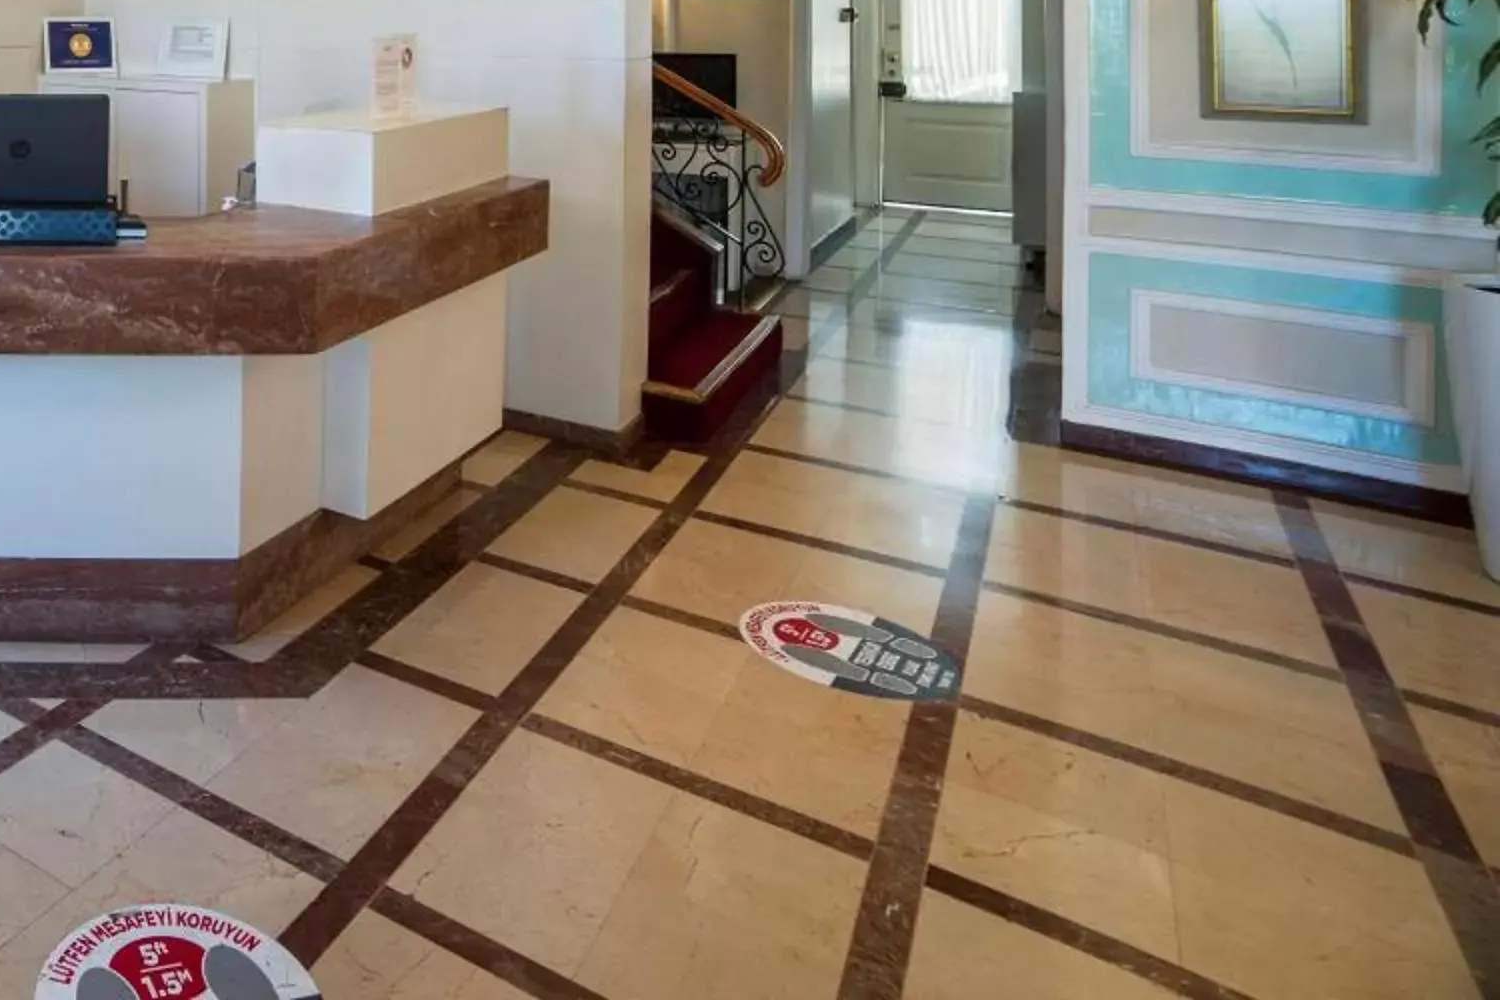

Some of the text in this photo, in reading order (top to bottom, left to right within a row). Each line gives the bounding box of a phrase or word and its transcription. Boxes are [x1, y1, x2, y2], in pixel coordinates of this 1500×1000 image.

[49, 906, 262, 986] LÜTFEN MESAFEYİ KORUYUN
